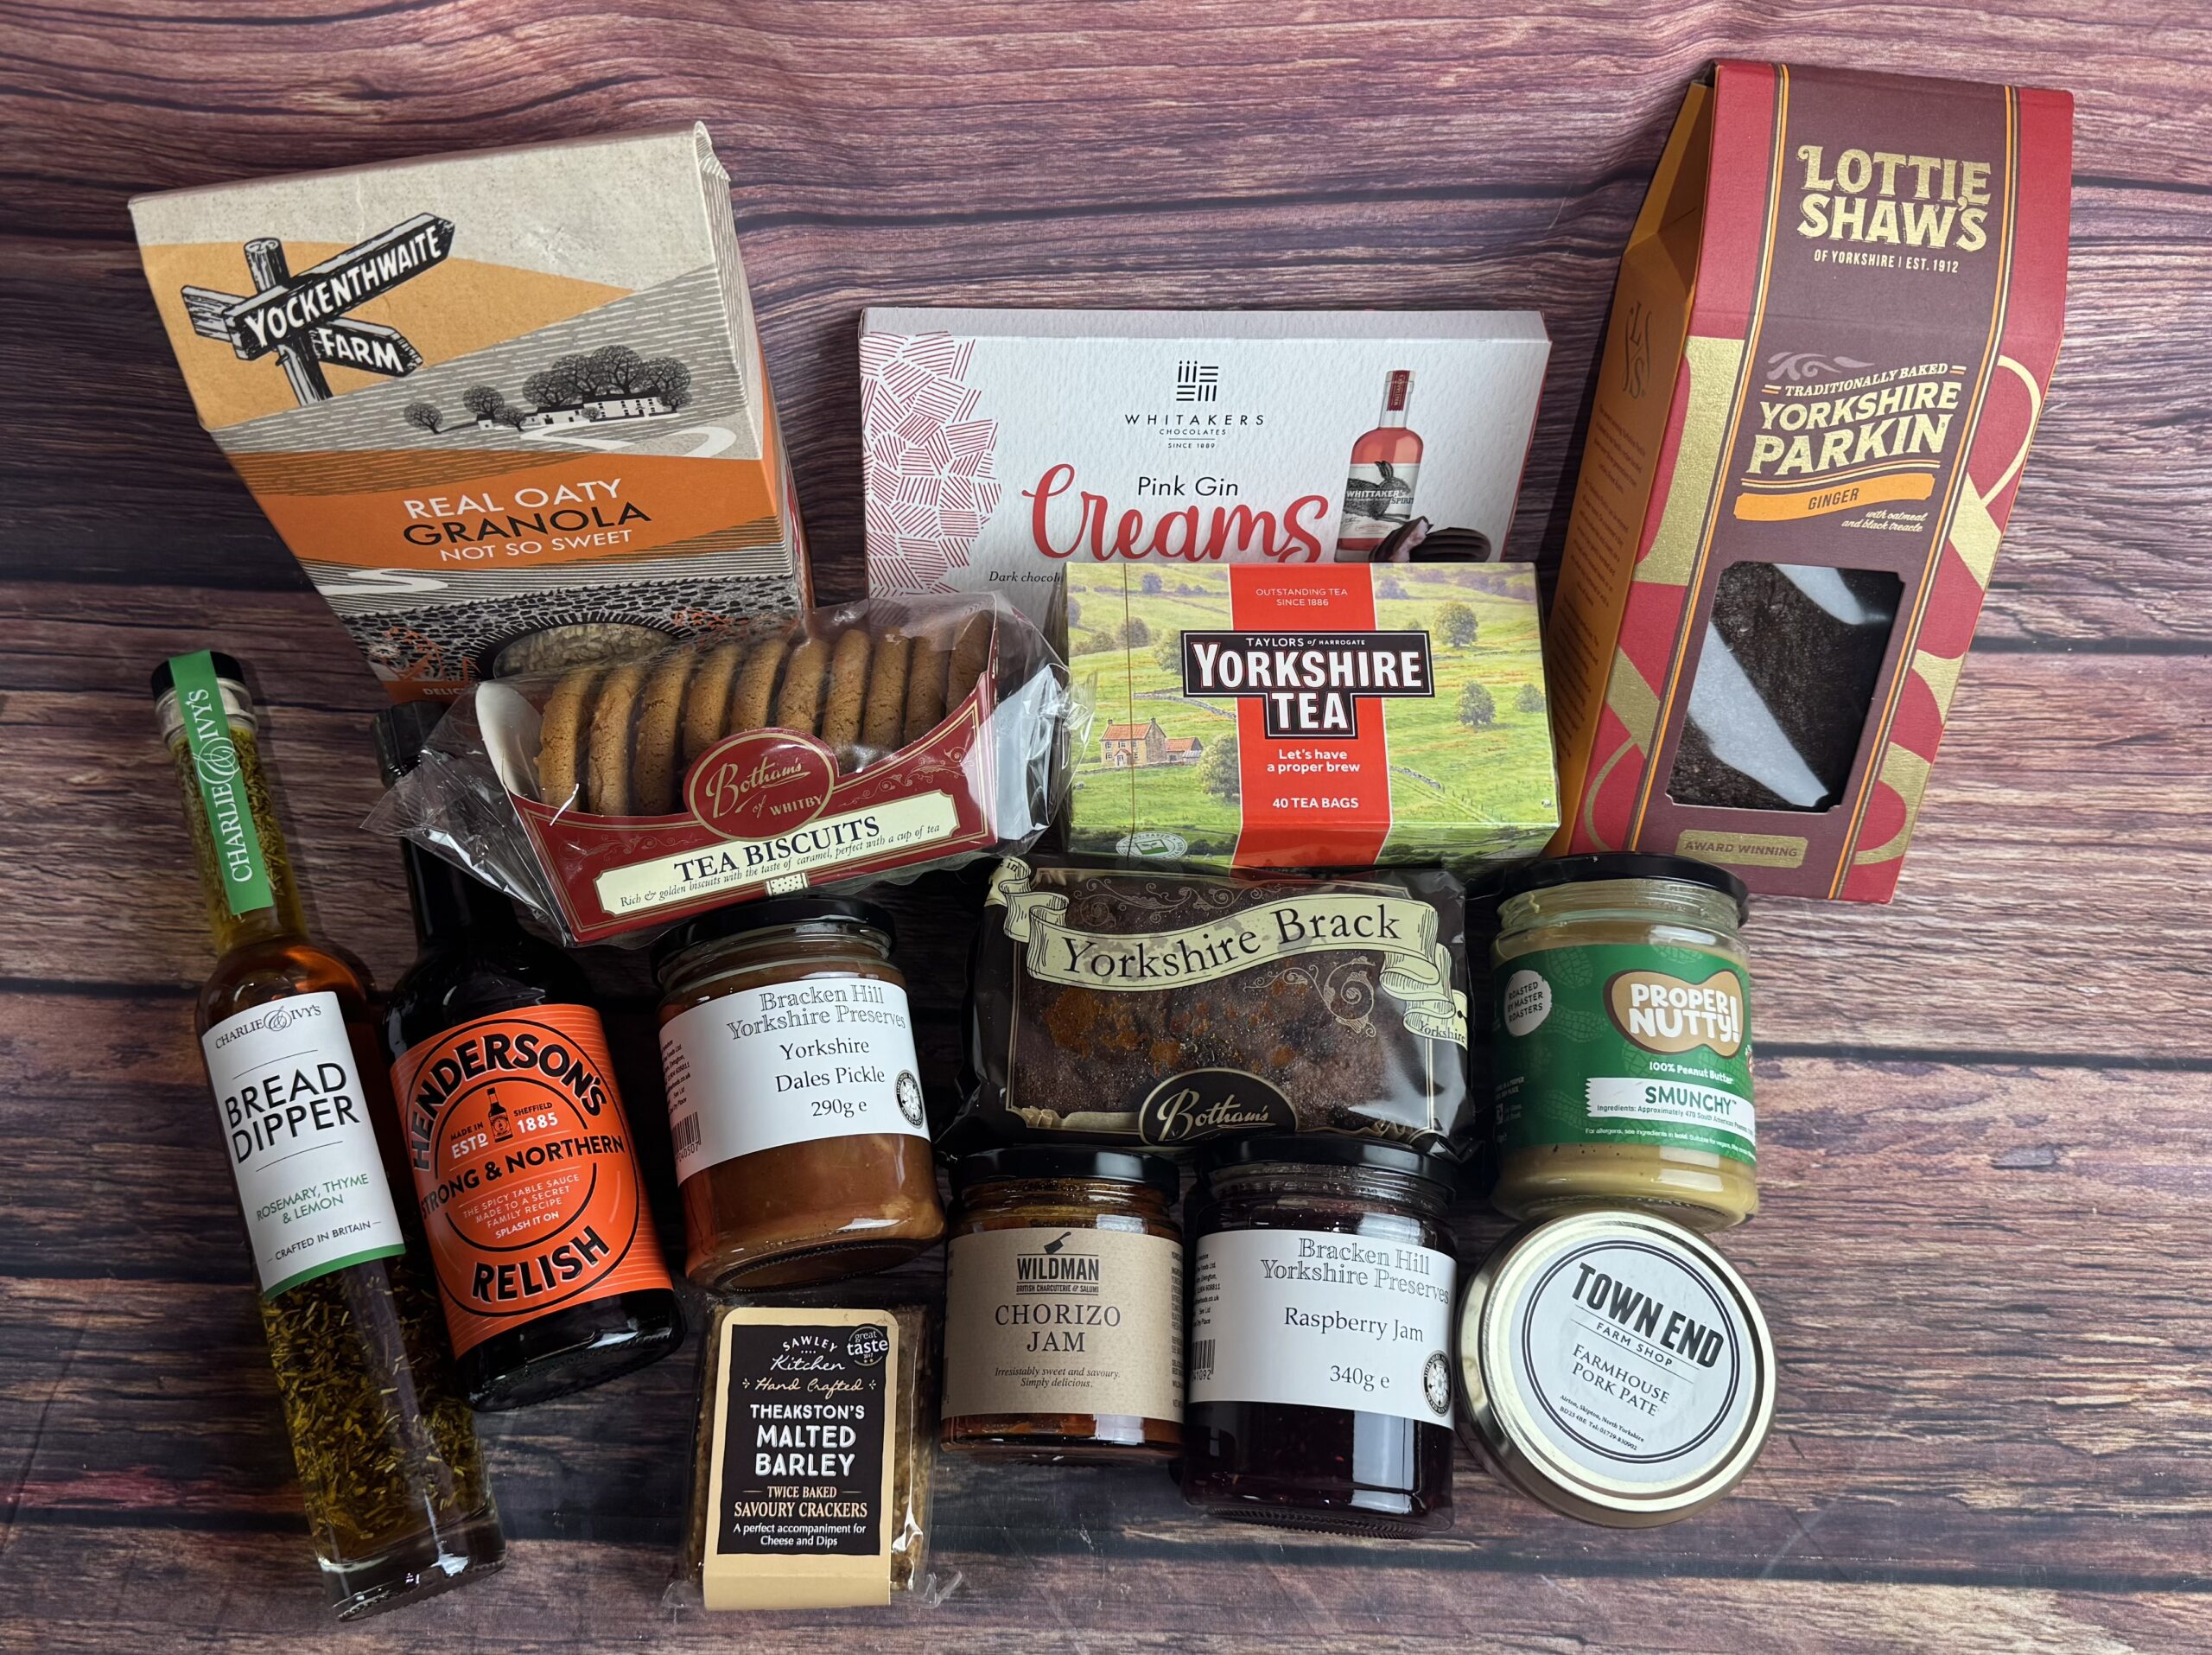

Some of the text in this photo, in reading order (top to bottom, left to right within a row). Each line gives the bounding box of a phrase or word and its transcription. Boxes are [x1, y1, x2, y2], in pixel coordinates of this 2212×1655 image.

[1796, 145, 1991, 206] LOTTIE
[1815, 249, 1959, 273] OF YORKSHIRE EST. 1912
[245, 225, 442, 347] YOCKENTHWAITE
[321, 328, 404, 373] FARM
[1785, 363, 1948, 397] TRADITIONALLY BAKED
[1124, 413, 1266, 426] WHITAKERS
[1759, 381, 1962, 431] YORKSHIRE
[1745, 413, 1954, 475] PARKIN
[404, 478, 621, 519] REAL OATY
[1136, 474, 1239, 497] Pink Gin
[1808, 487, 1859, 511] GINGER
[404, 502, 652, 546] GRANOLA
[1021, 463, 1330, 563] Creams
[440, 530, 632, 562] NOT SO SWEET
[1255, 588, 1348, 596] OUTSTANDING TEA
[1276, 598, 1329, 607] SINCE 1886
[1192, 643, 1423, 689] YORKSHIRE
[185, 689, 219, 742] IVY'S
[1271, 692, 1349, 729] TEA
[1278, 749, 1347, 760] Let's have
[1278, 763, 1325, 774] proper
[1326, 761, 1360, 773] brew
[1273, 798, 1359, 808] 40 TEA BAGS
[211, 781, 253, 883] CHARLIE
[674, 816, 880, 882] TEA BISCUITS
[1684, 840, 1797, 858] AWARD WINNING
[620, 893, 642, 907] Rich
[659, 886, 686, 901] golden
[689, 876, 721, 891] biscuits
[723, 869, 743, 883] with
[746, 865, 759, 877] the
[760, 862, 780, 874] taste
[783, 857, 792, 870] of
[797, 848, 833, 865] caramel,
[836, 842, 863, 859] perfect
[866, 835, 886, 849] with
[897, 831, 912, 843] cup
[914, 825, 924, 839] of
[927, 824, 940, 834] tea
[1062, 904, 1402, 977] Yorkshire Brack
[759, 983, 885, 1012] Bracken Hill
[1509, 1003, 1543, 1022] ROASTERS
[1513, 991, 1544, 1009] MASTER
[1630, 983, 1728, 1015] PROPER
[215, 1018, 264, 1049] CHARLIE
[290, 1003, 322, 1022] IVY'S
[727, 1005, 906, 1040] Yorkshire Preserves
[1629, 996, 1739, 1043] NUTTY!
[779, 1037, 870, 1060] Yorkshire
[774, 1066, 886, 1092] Dales Pickle
[225, 1062, 347, 1130] BREAD
[411, 1032, 607, 1172] HENDERSON'S
[513, 1102, 553, 1117] SHEFFIELD
[1637, 1105, 1684, 1117] Approximately
[231, 1095, 361, 1164] DIPPER
[451, 1112, 558, 1159] ESTD 1885
[421, 1135, 626, 1219] STRONG & NORTHERN
[257, 1174, 369, 1222] ROSEMARY, THYME
[283, 1194, 344, 1224] & LEMON
[486, 1198, 563, 1228] FAMILY RECIPE
[494, 1211, 560, 1239] SPLASH IT ON
[275, 1221, 371, 1261] CRAFTED IN BRITAIN
[1297, 1238, 1431, 1275] Bracken Hill
[472, 1225, 610, 1303] RELISH
[1017, 1257, 1099, 1281] WILDMAN
[1261, 1259, 1450, 1304] Yorkshire Preserves
[995, 1303, 1121, 1327] CHORIZO
[1284, 1307, 1424, 1342] Raspberry Jam
[1572, 1262, 1725, 1368] TOWN END
[782, 1335, 838, 1353] SAWLEY
[847, 1340, 888, 1356] taste
[1027, 1331, 1085, 1353] JAM
[1597, 1321, 1674, 1367] FARM SHOP
[770, 1354, 845, 1371] Kitchen
[995, 1366, 1121, 1379] Irresistably sweet and savoury.
[1572, 1342, 1670, 1404] FARMHOUSE
[754, 1378, 863, 1399] Hand Crafted
[1020, 1377, 1093, 1388] Simply delicious.
[1329, 1365, 1390, 1392] 340g e
[1571, 1362, 1659, 1416] PORK PATE
[750, 1404, 865, 1420] THEAKSTON'S
[1560, 1394, 1644, 1442] Airton, Skipton, North Yorkshire
[756, 1424, 856, 1448] MALTED
[755, 1453, 855, 1477] BARLEY
[767, 1486, 837, 1499] TWICE BAKED
[734, 1501, 868, 1518] SAVOURY CRACKERS
[733, 1523, 867, 1536] A perfect accompaniment for
[760, 1535, 838, 1549] Cheese and Dips
